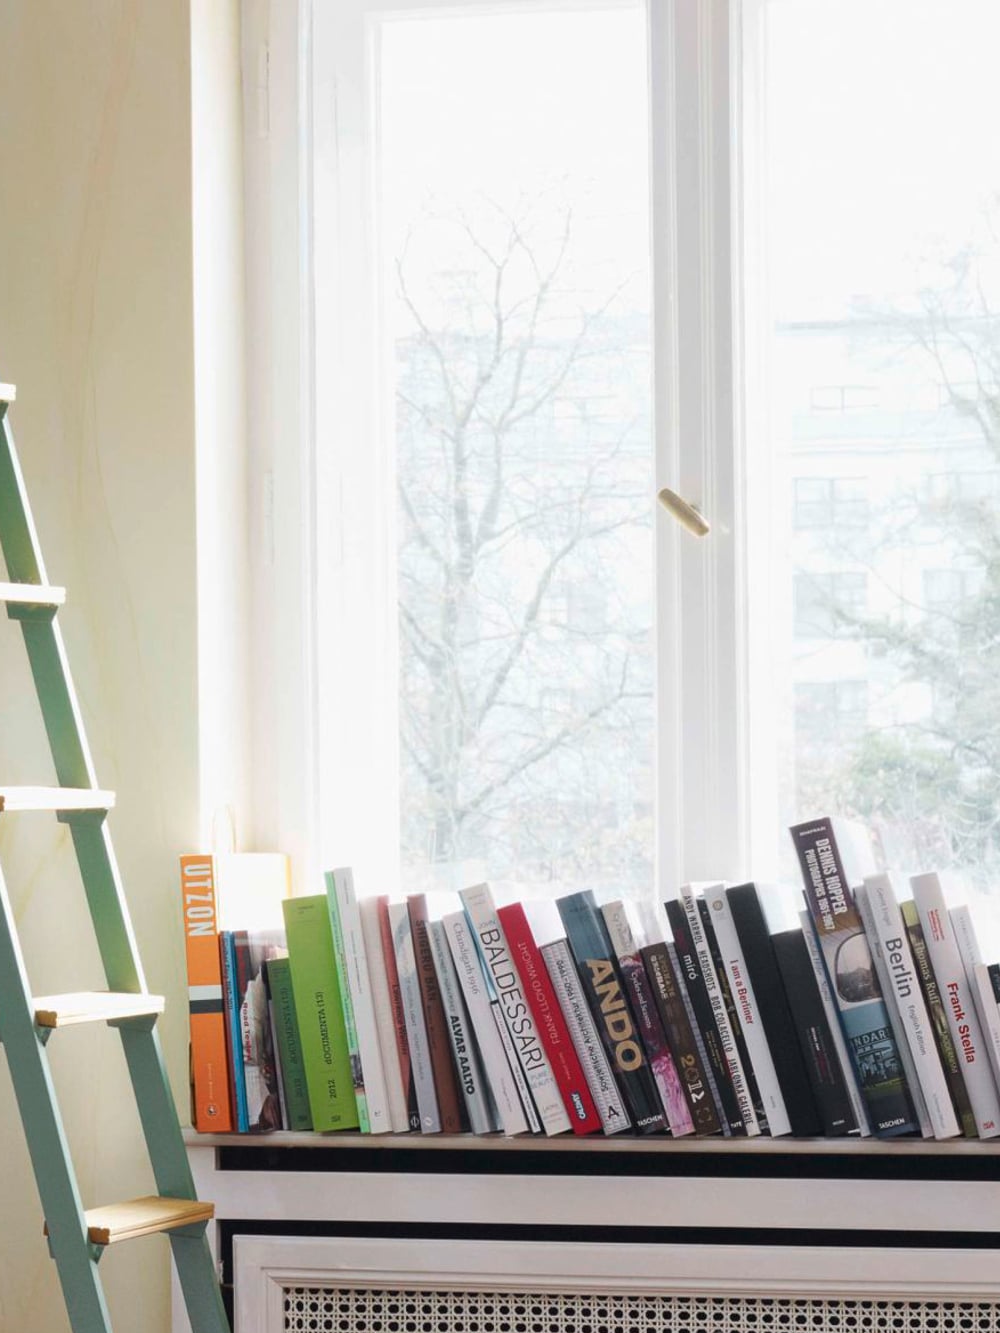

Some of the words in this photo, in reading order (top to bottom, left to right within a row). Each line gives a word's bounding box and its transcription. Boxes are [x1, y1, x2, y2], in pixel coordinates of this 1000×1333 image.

[804, 849, 824, 897] PHOTOGRAPHS
[815, 838, 832, 880] DENNIS
[828, 878, 847, 915] HOPPER
[183, 863, 215, 937] UTZON
[681, 893, 696, 916] ANDY
[453, 921, 474, 976] Chandigarh
[686, 914, 704, 946] WARHOL
[515, 939, 539, 981] WRIGHT
[683, 954, 697, 980] miró
[699, 950, 716, 991] HEADSHOTS
[729, 957, 738, 965] I
[729, 964, 742, 980] am
[886, 937, 912, 998] Berlin
[914, 941, 930, 982] Thomas
[314, 990, 325, 1007] (13)
[480, 928, 546, 1071] BALDESSARI
[529, 978, 550, 1012] LLOYD
[709, 994, 722, 1012] BOB
[734, 979, 744, 988] a
[569, 1000, 592, 1045] Architektur
[585, 958, 644, 1071] ANDO
[737, 988, 754, 1024] Berliner
[947, 982, 967, 1021] Frank
[958, 1024, 975, 1063] Stella
[316, 1007, 333, 1065] dOCUMENTA
[541, 1011, 562, 1045] FRANK
[713, 1010, 735, 1054] COLACELLO
[907, 1004, 921, 1031] English
[914, 1030, 926, 1056] Edition
[450, 1015, 466, 1054] ALVAR
[459, 1053, 475, 1095] AALTO
[327, 1078, 337, 1099] 2012
[725, 1056, 745, 1096] JABLONKA
[636, 1112, 664, 1127] TASCHEN
[736, 1094, 754, 1126] GALERIE
[878, 1117, 905, 1129] TASCHEN
